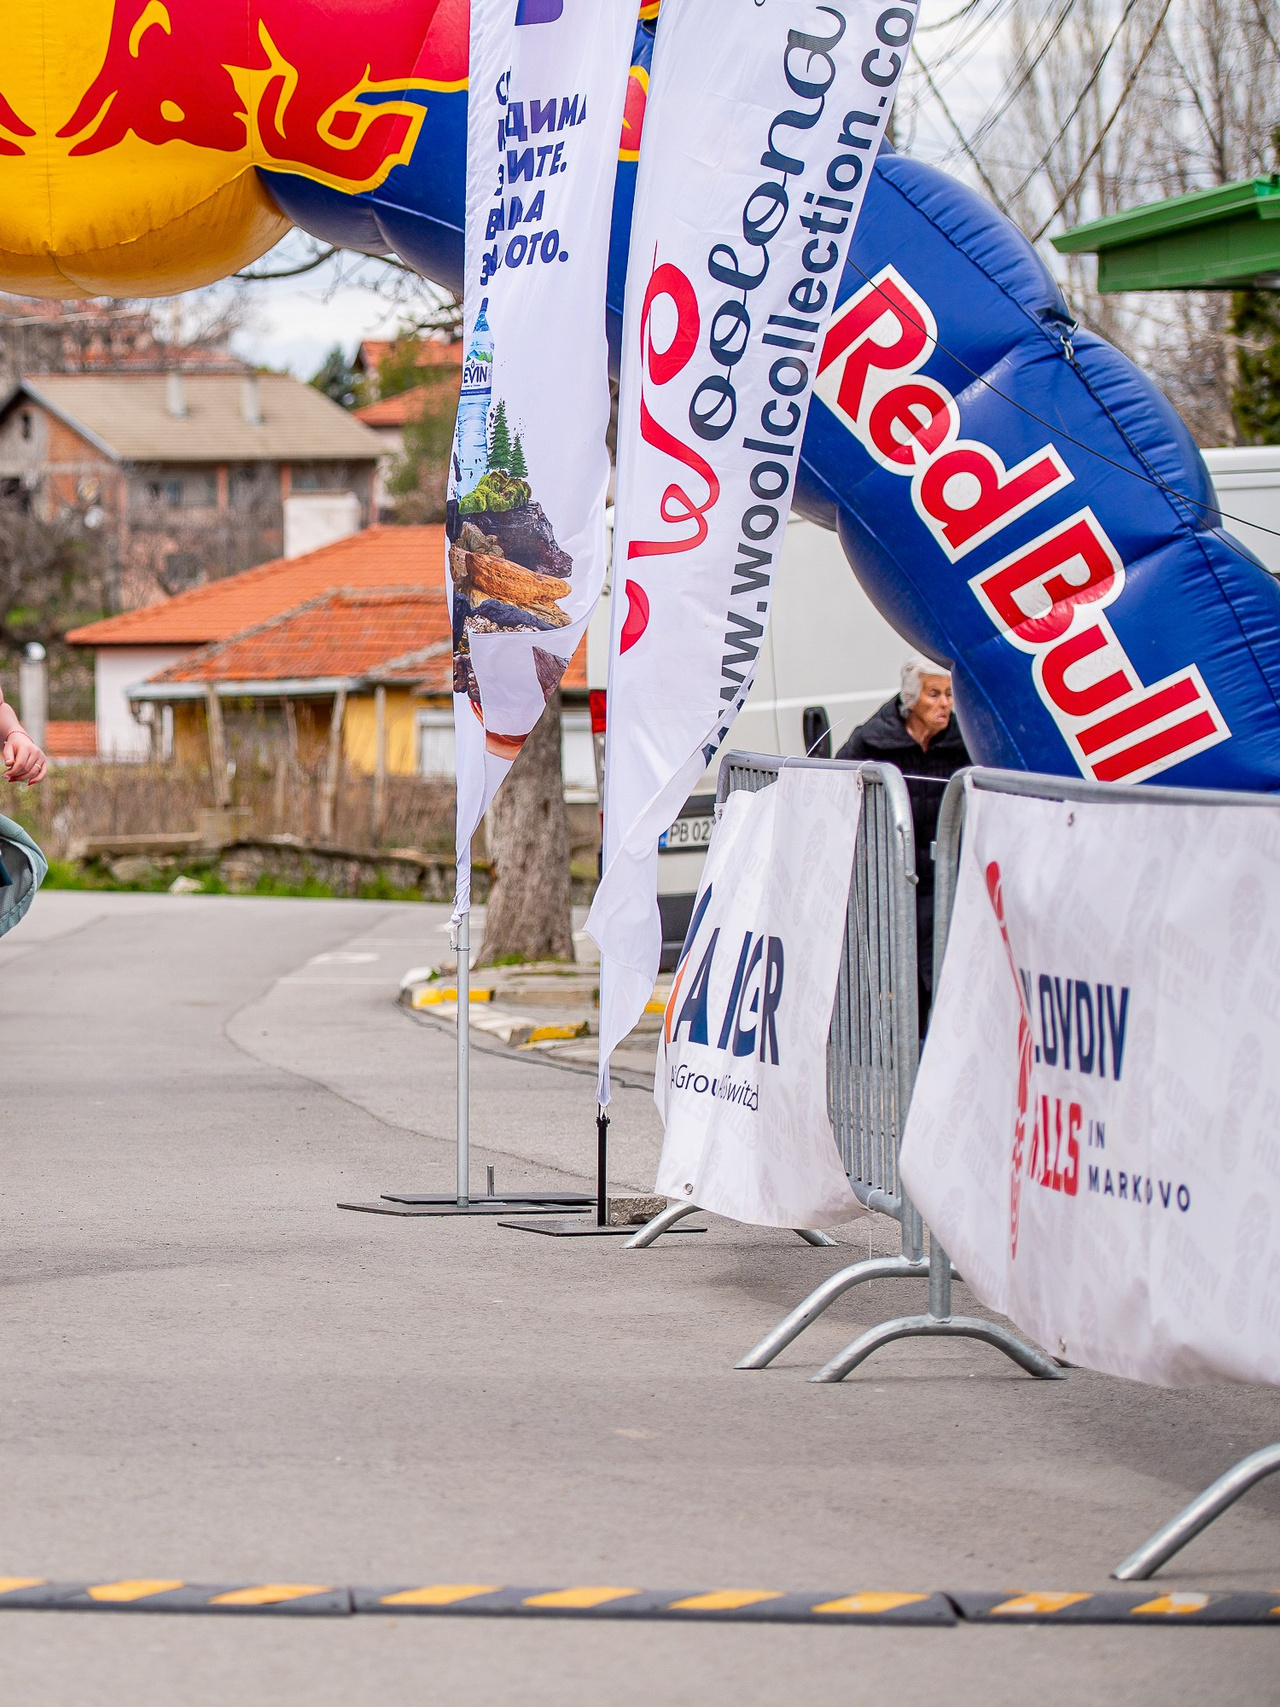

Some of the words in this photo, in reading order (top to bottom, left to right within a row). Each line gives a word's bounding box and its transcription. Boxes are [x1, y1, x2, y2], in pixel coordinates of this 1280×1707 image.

[463, 365, 488, 384] EVIN
[817, 273, 1065, 556] Red
[976, 513, 1223, 783] Bull
[692, 820, 713, 842] 02
[1020, 967, 1131, 1082] OVDIV
[1088, 1120, 1106, 1149] IN
